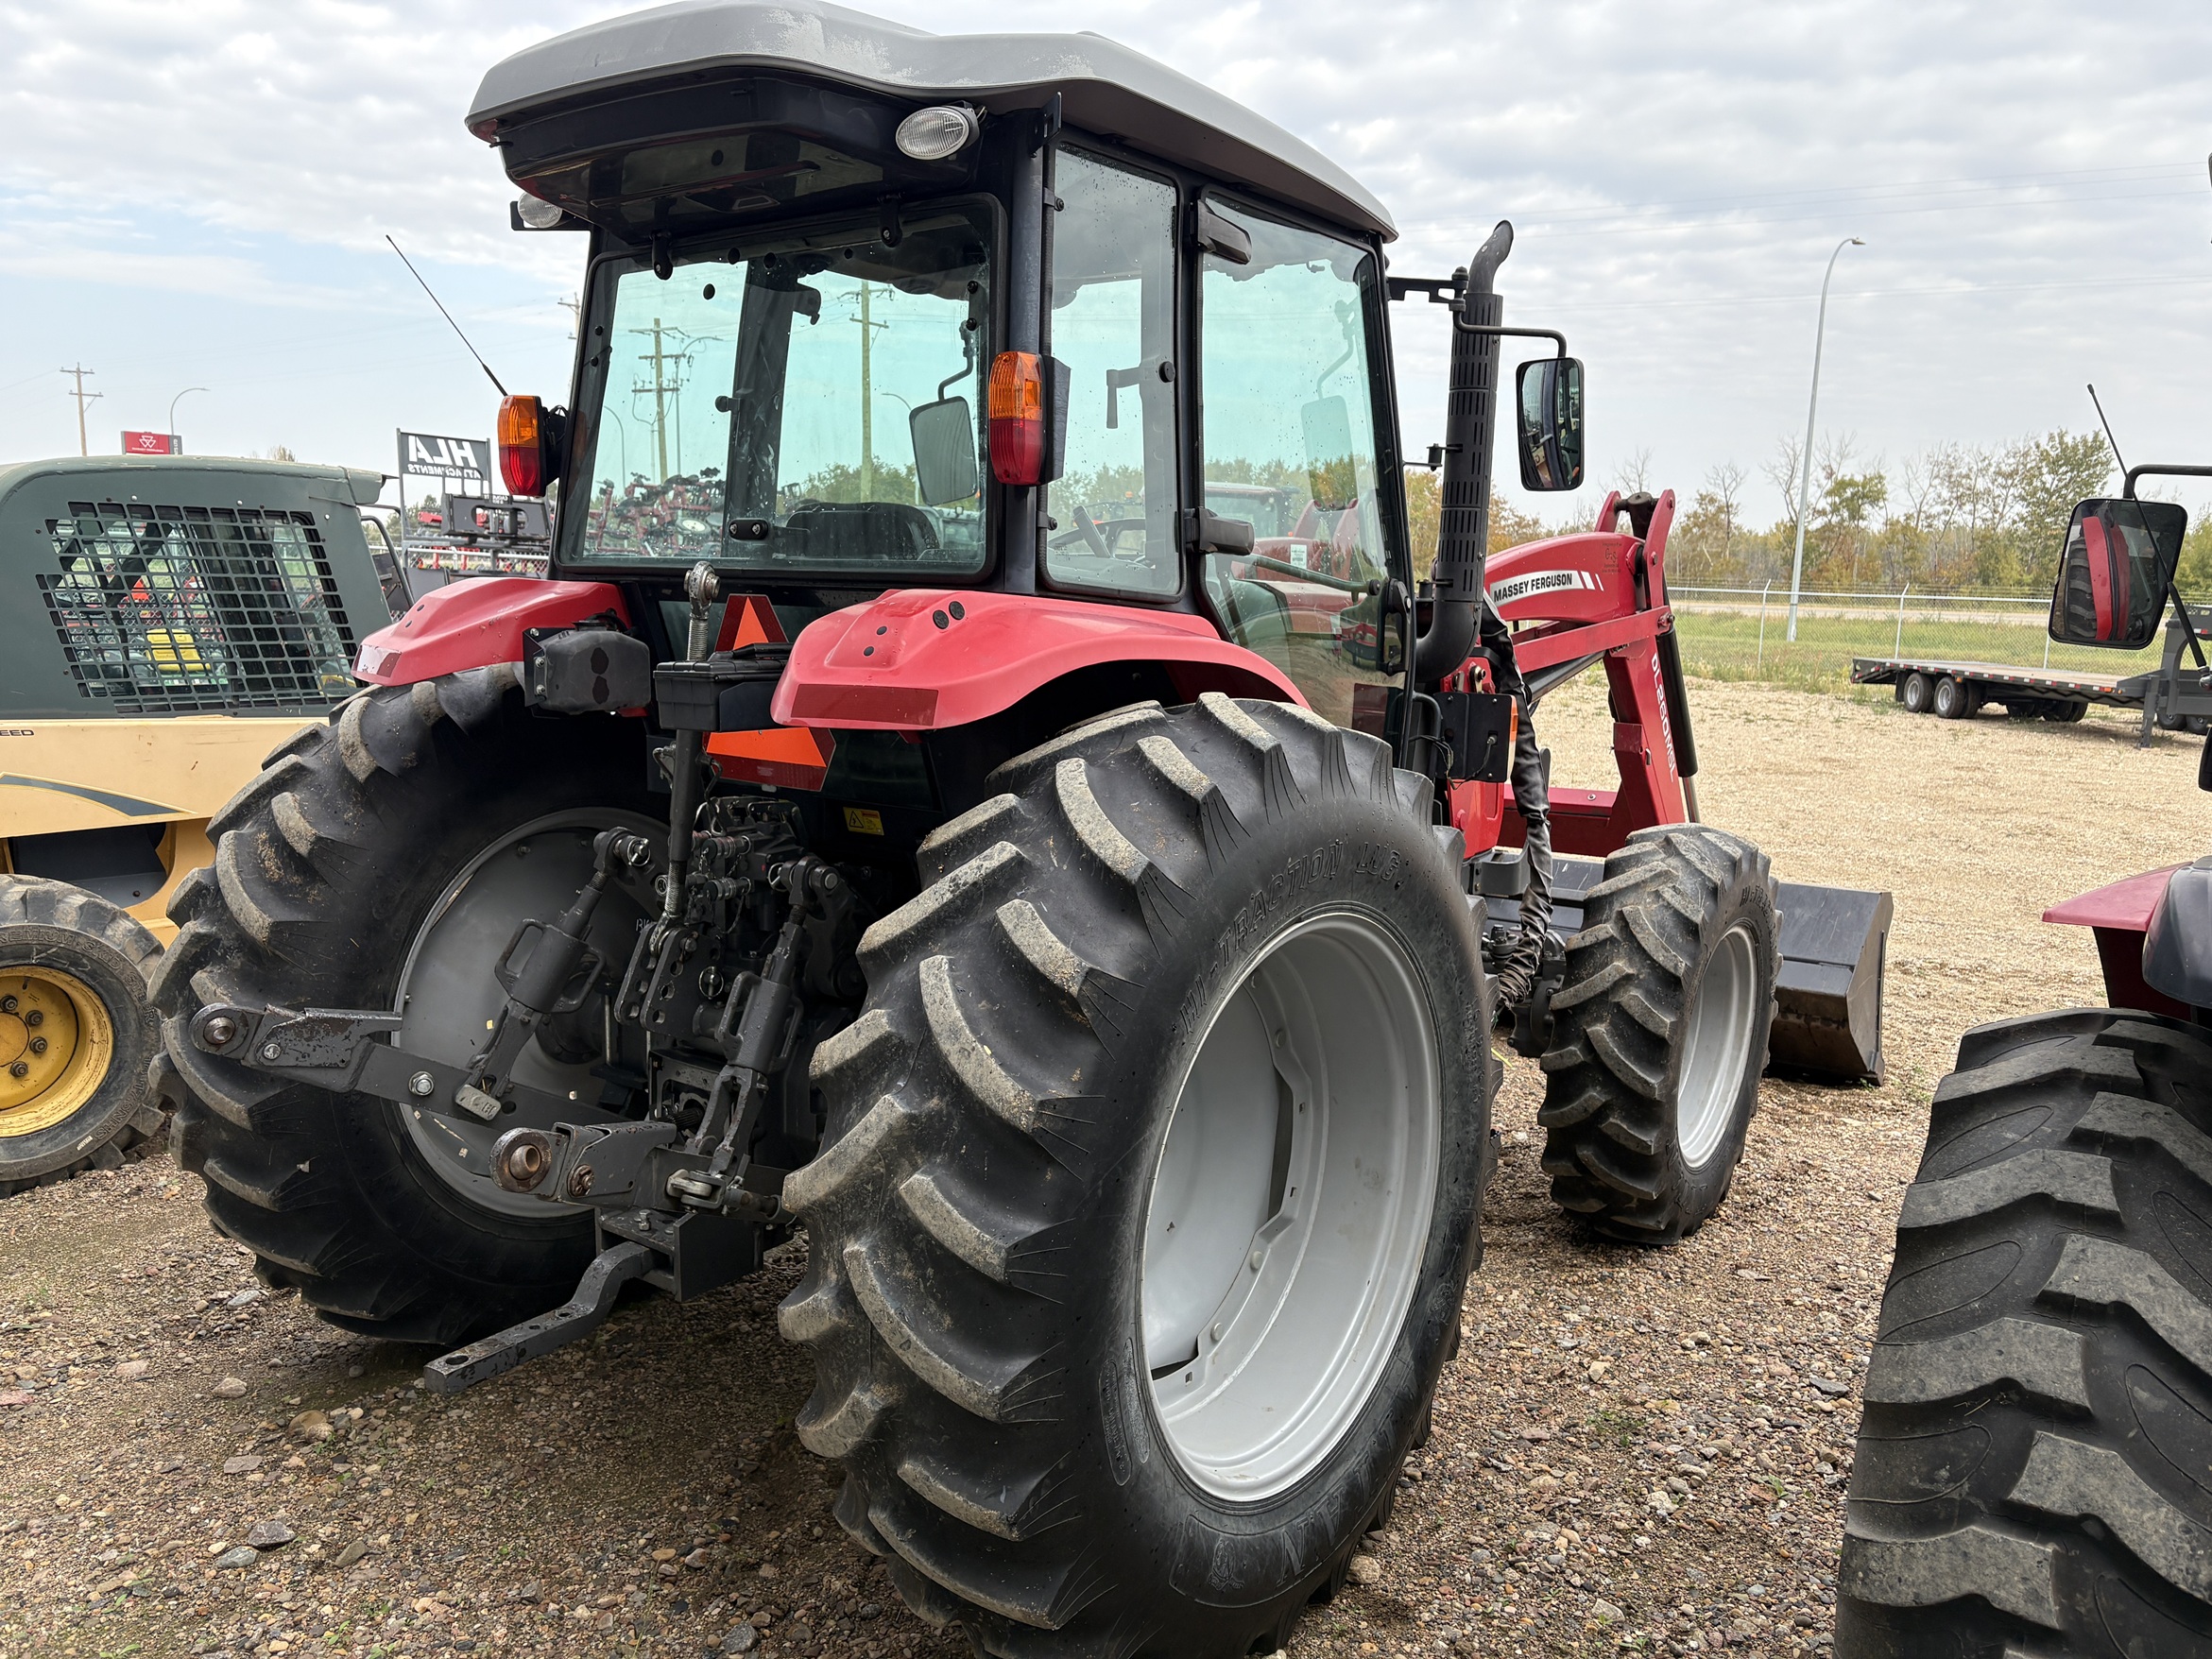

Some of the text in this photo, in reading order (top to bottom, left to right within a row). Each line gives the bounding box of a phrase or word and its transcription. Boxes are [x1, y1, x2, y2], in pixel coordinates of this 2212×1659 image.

[1493, 573, 1573, 603] MASSEY FERGUSON
[1355, 841, 1401, 881] LUG
[81, 940, 123, 972] SKID
